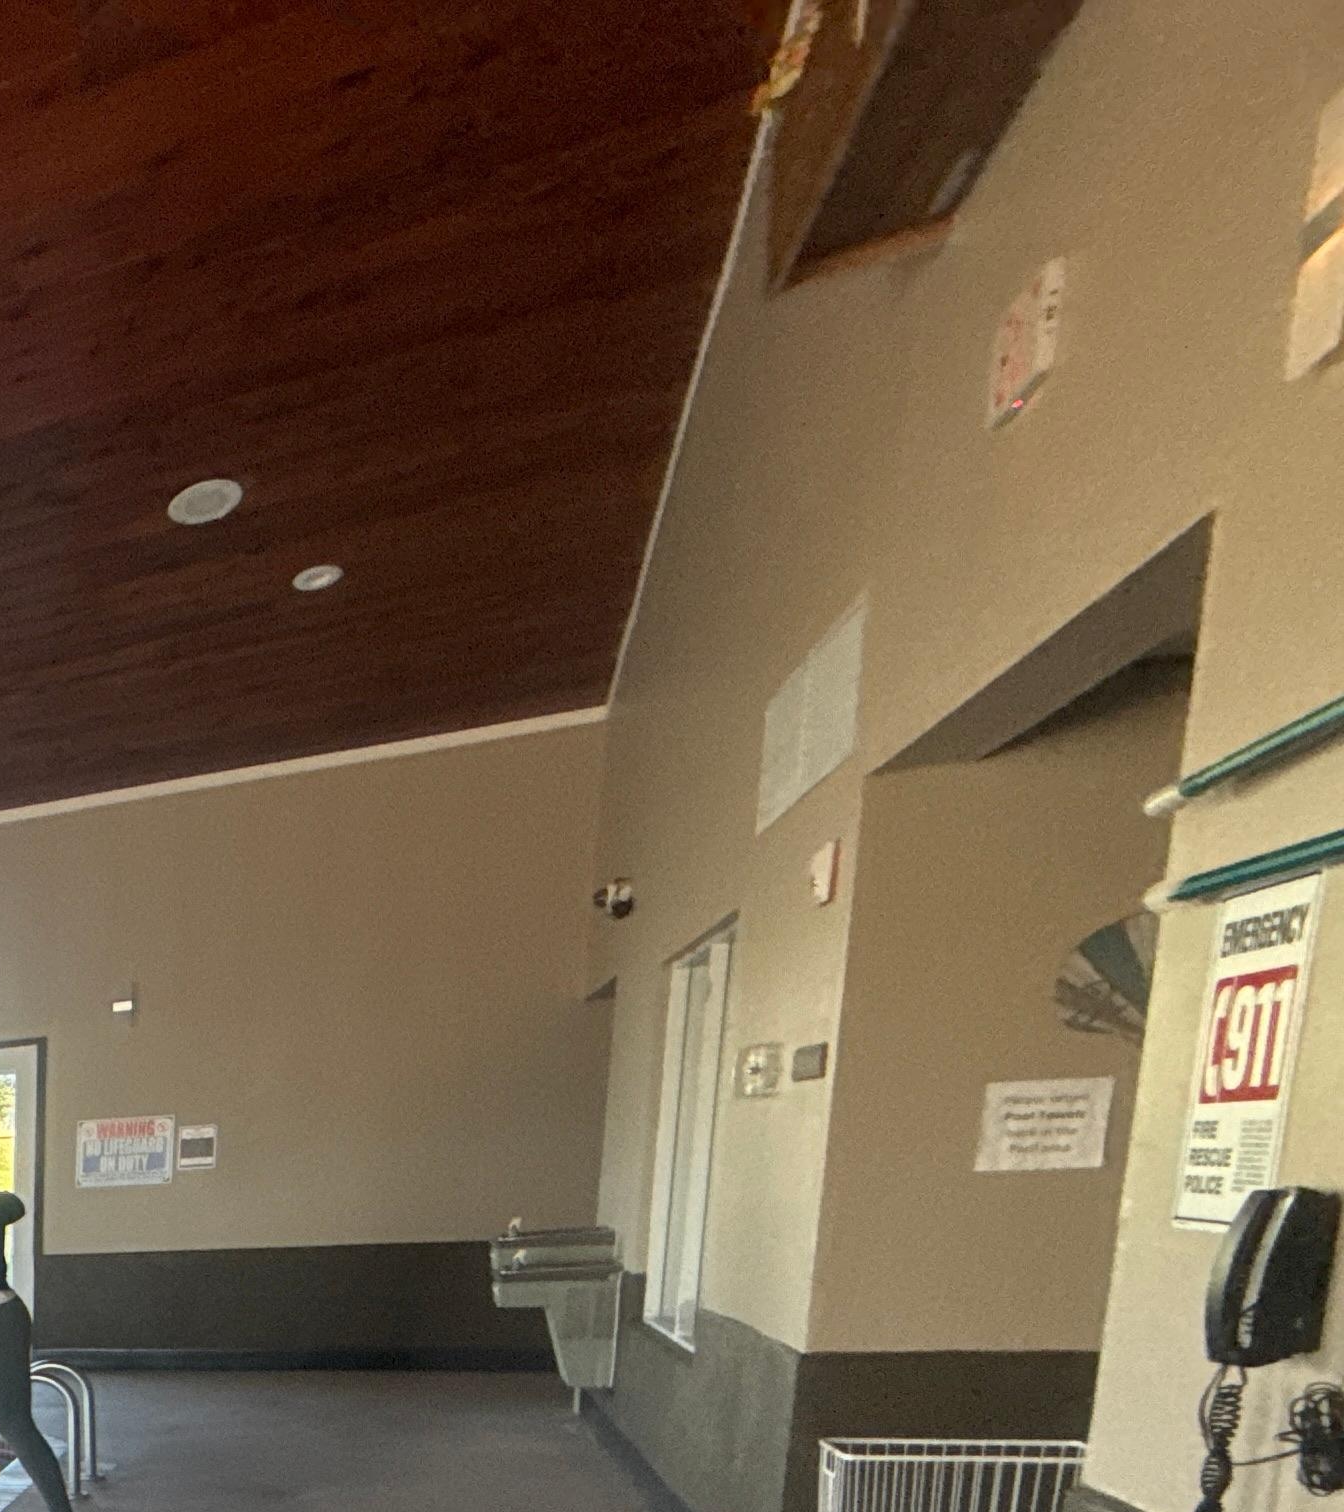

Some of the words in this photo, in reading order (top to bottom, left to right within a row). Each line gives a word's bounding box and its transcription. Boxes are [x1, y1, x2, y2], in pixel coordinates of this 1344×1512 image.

[1220, 902, 1311, 958] EMERGENCY
[1221, 979, 1296, 1091] 911
[96, 1119, 156, 1139] WARNING
[85, 1140, 102, 1156] NO
[103, 1136, 164, 1155] LIFEGUARD
[99, 1155, 116, 1173] ON
[117, 1154, 150, 1172] DUTY
[1188, 1148, 1233, 1167] RESCUE
[1183, 1175, 1224, 1195] POLICE
